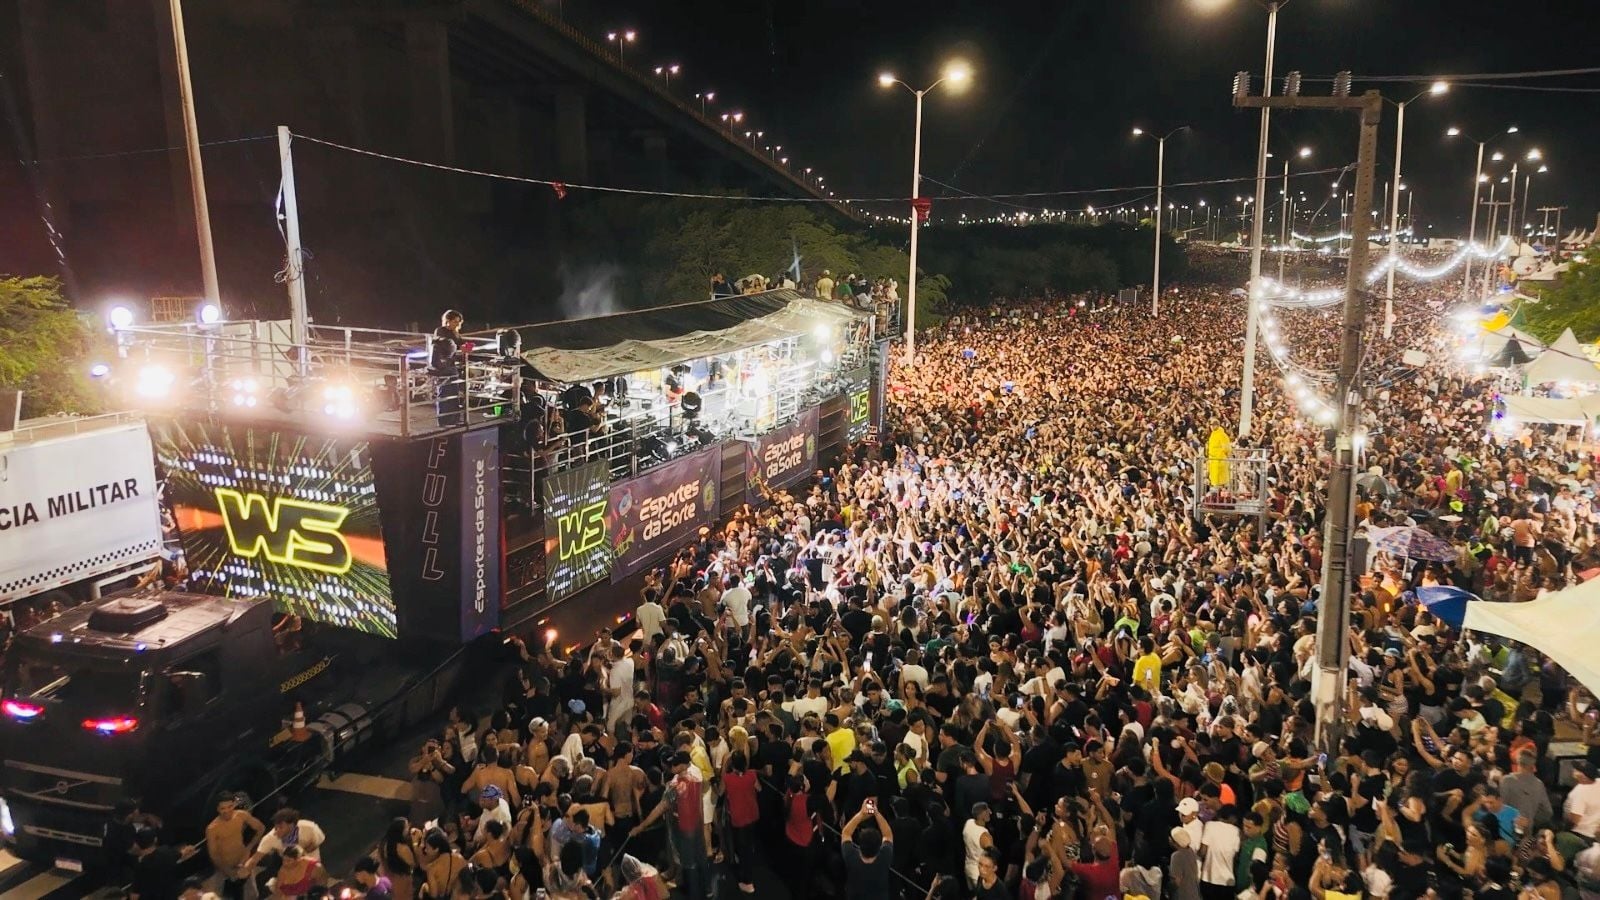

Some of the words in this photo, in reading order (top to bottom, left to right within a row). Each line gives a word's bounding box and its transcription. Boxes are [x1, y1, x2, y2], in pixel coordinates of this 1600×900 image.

[851, 391, 869, 423] WS
[765, 433, 804, 462] Esportes
[47, 478, 139, 519] MILITAR
[640, 480, 700, 521] Esportes
[214, 487, 352, 575] WS
[558, 500, 608, 560] WS
[475, 533, 486, 613] Esportes
